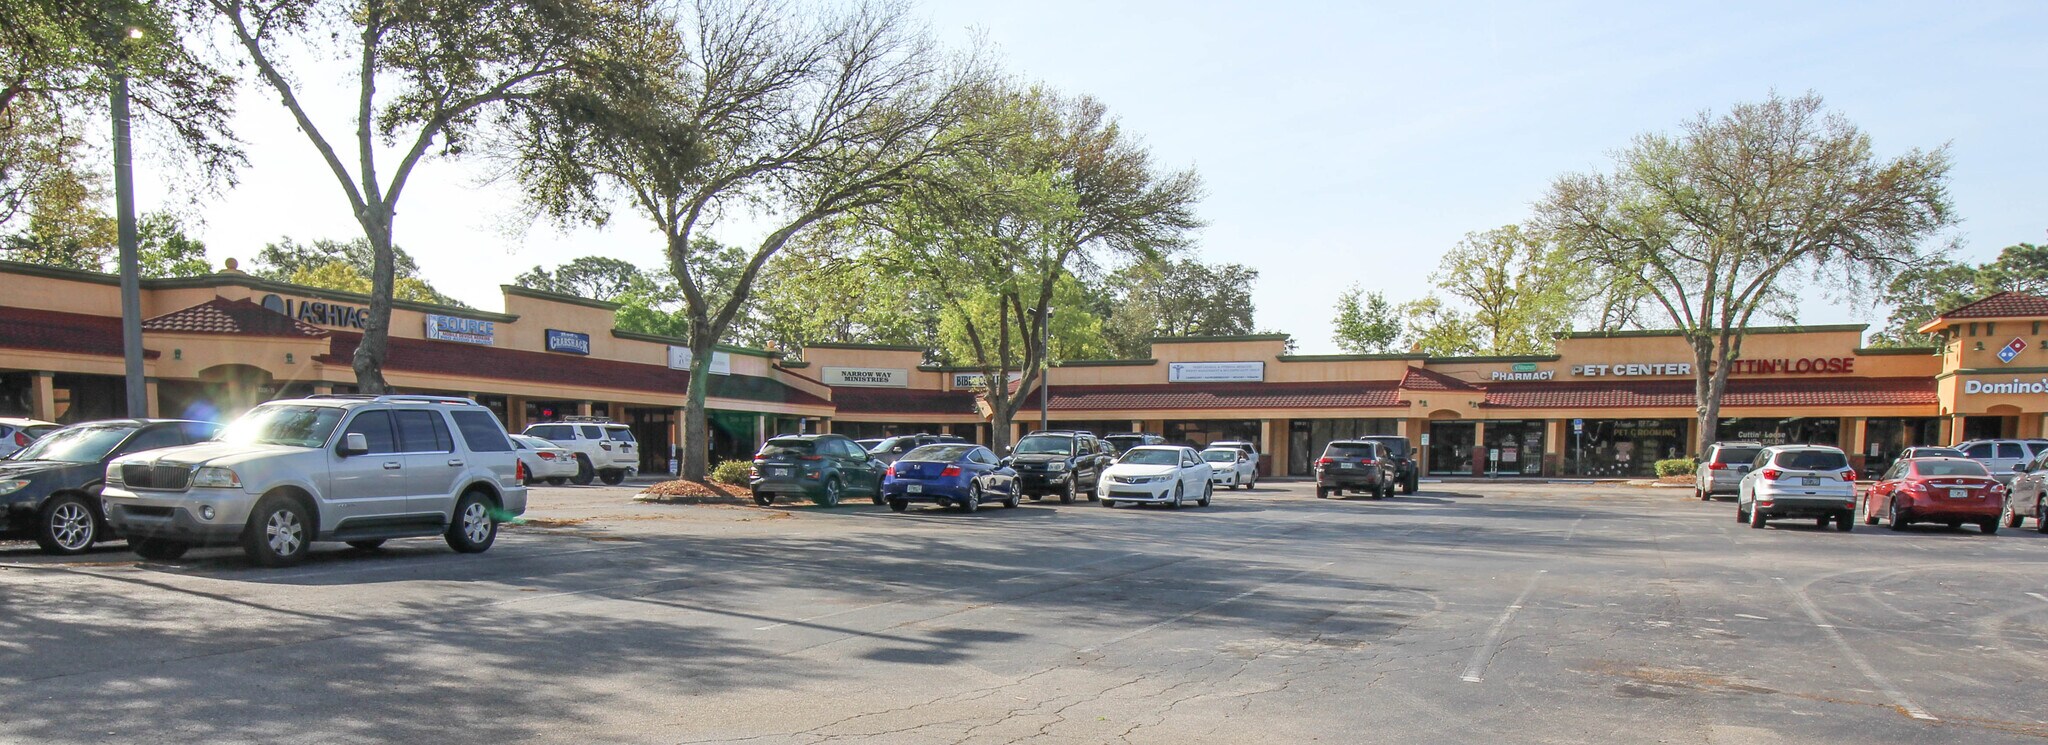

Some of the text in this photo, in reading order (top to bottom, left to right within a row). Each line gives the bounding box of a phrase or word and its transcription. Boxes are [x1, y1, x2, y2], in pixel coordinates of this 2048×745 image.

[438, 316, 494, 336] SOURCE
[1571, 363, 1691, 376] PET CENTER
[1785, 358, 1854, 375] LOOSE
[1492, 371, 1554, 381] PHARMACY
